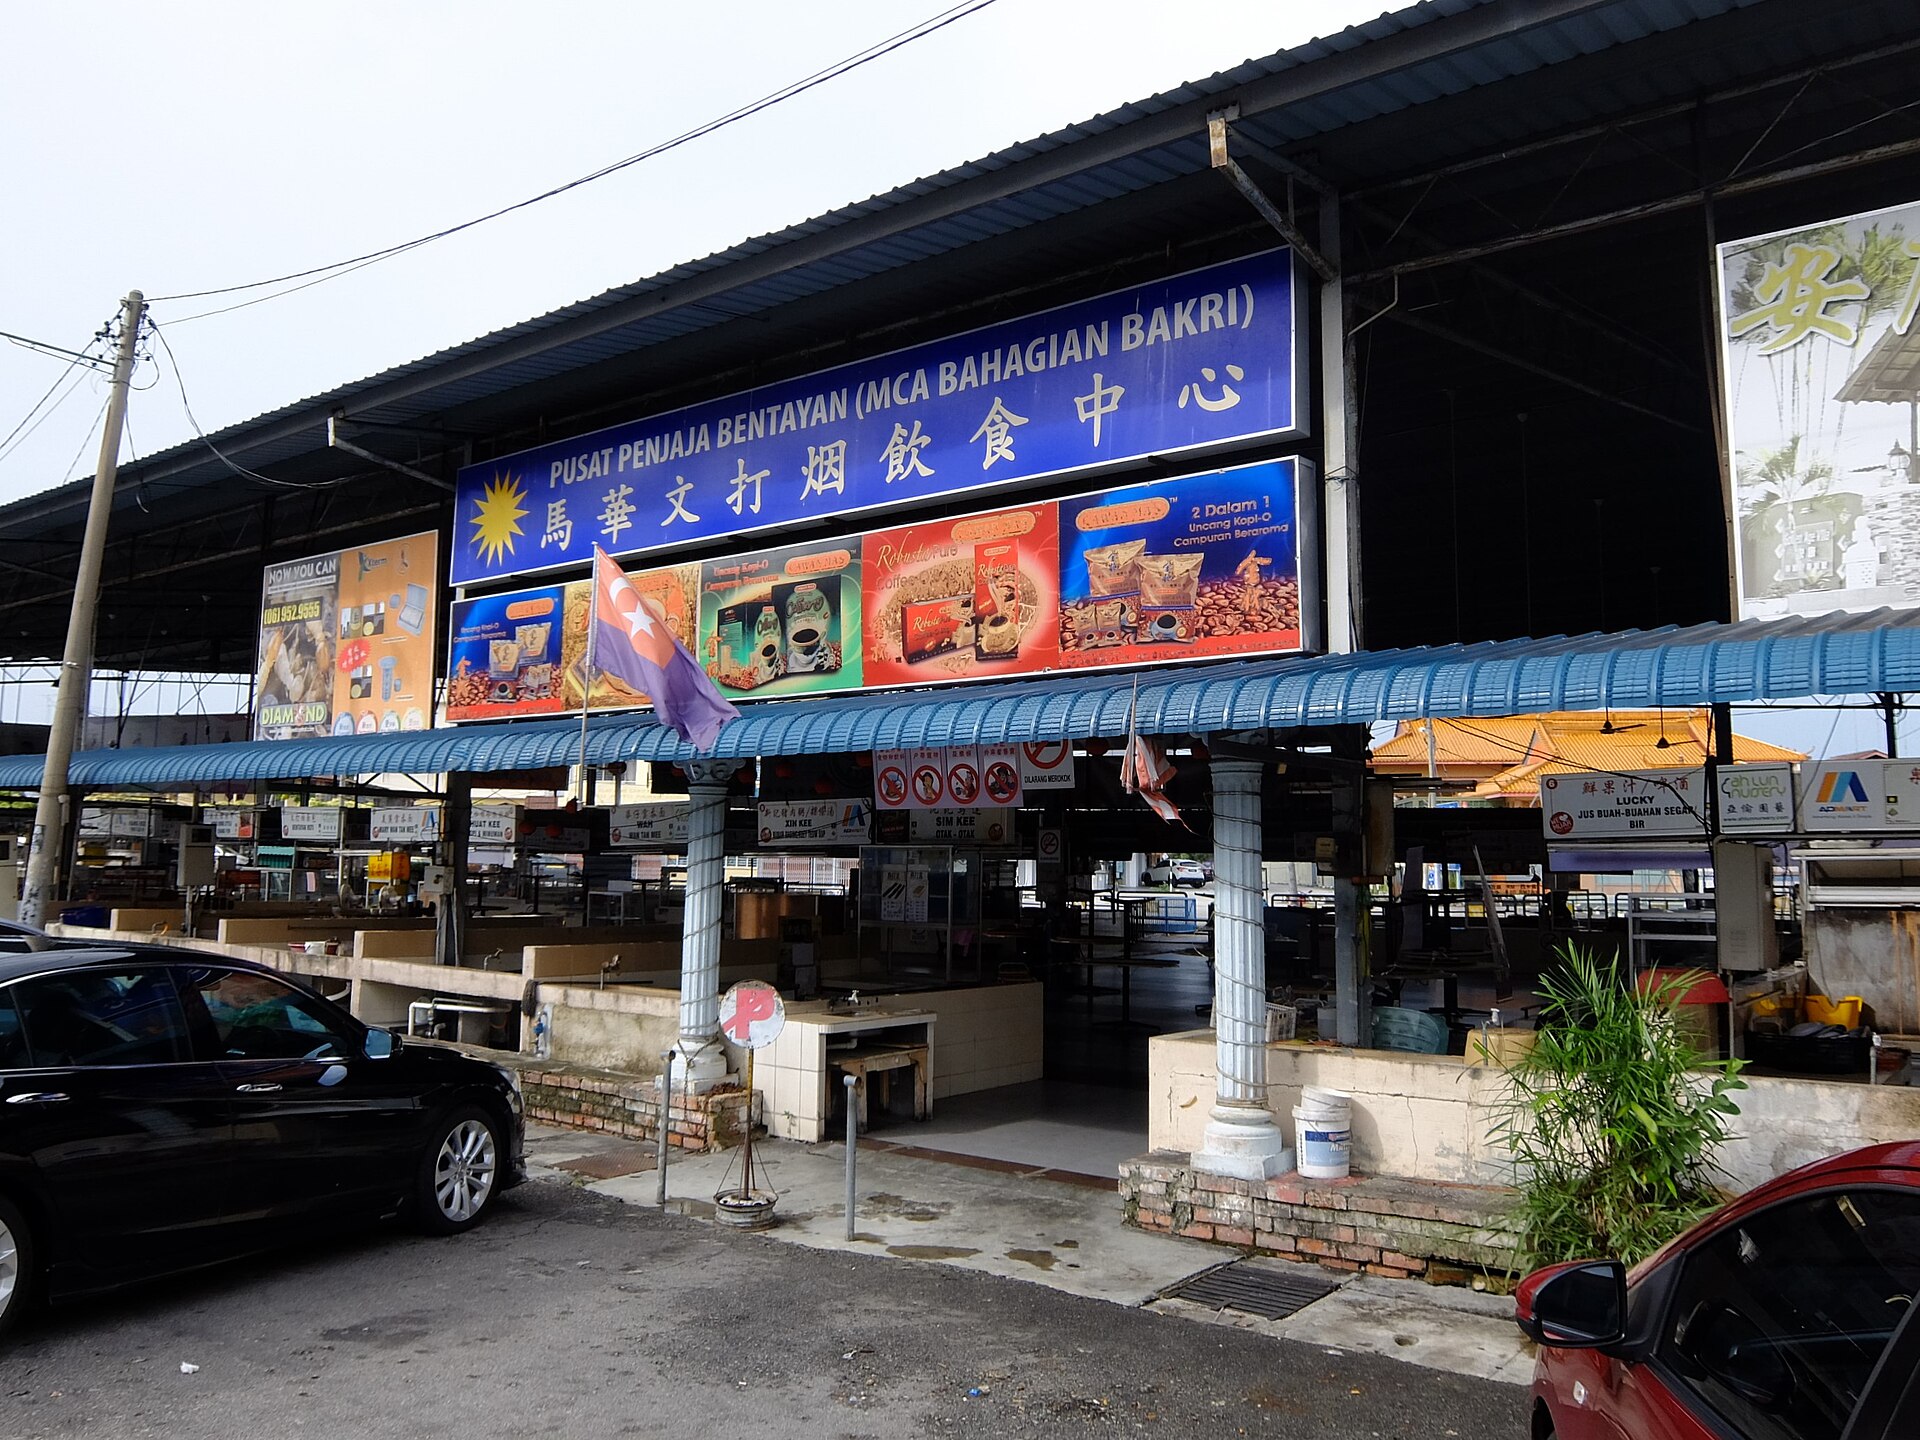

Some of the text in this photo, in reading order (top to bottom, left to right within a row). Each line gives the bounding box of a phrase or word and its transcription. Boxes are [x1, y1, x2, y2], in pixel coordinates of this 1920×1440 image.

[549, 283, 1256, 489] PUSAT PENJAJA BENTAYAN (MCA BAHAGIAN BAKRI)
[540, 364, 1246, 552] 馬華文打烟飲食中心
[1191, 495, 1270, 519] 2 Dalam 1
[1189, 512, 1272, 532] Uncang Kopi-O
[1173, 523, 1289, 547] Campuran Beraroma
[268, 559, 337, 584] NOW YOU CAN
[264, 600, 321, 625] (06) 952.9555
[1024, 774, 1048, 784] DILARANG
[1616, 795, 1655, 806] LUCKY
[1578, 809, 1595, 819] JUS
[1597, 807, 1662, 818] BUAH-BUAHAN
[488, 820, 501, 829] KEE
[785, 818, 813, 828] XIN KEE
[935, 815, 976, 827] SIM KEE
[1629, 820, 1646, 829] BIR
[935, 829, 953, 839] OTAK
[957, 829, 976, 839] OTAK
